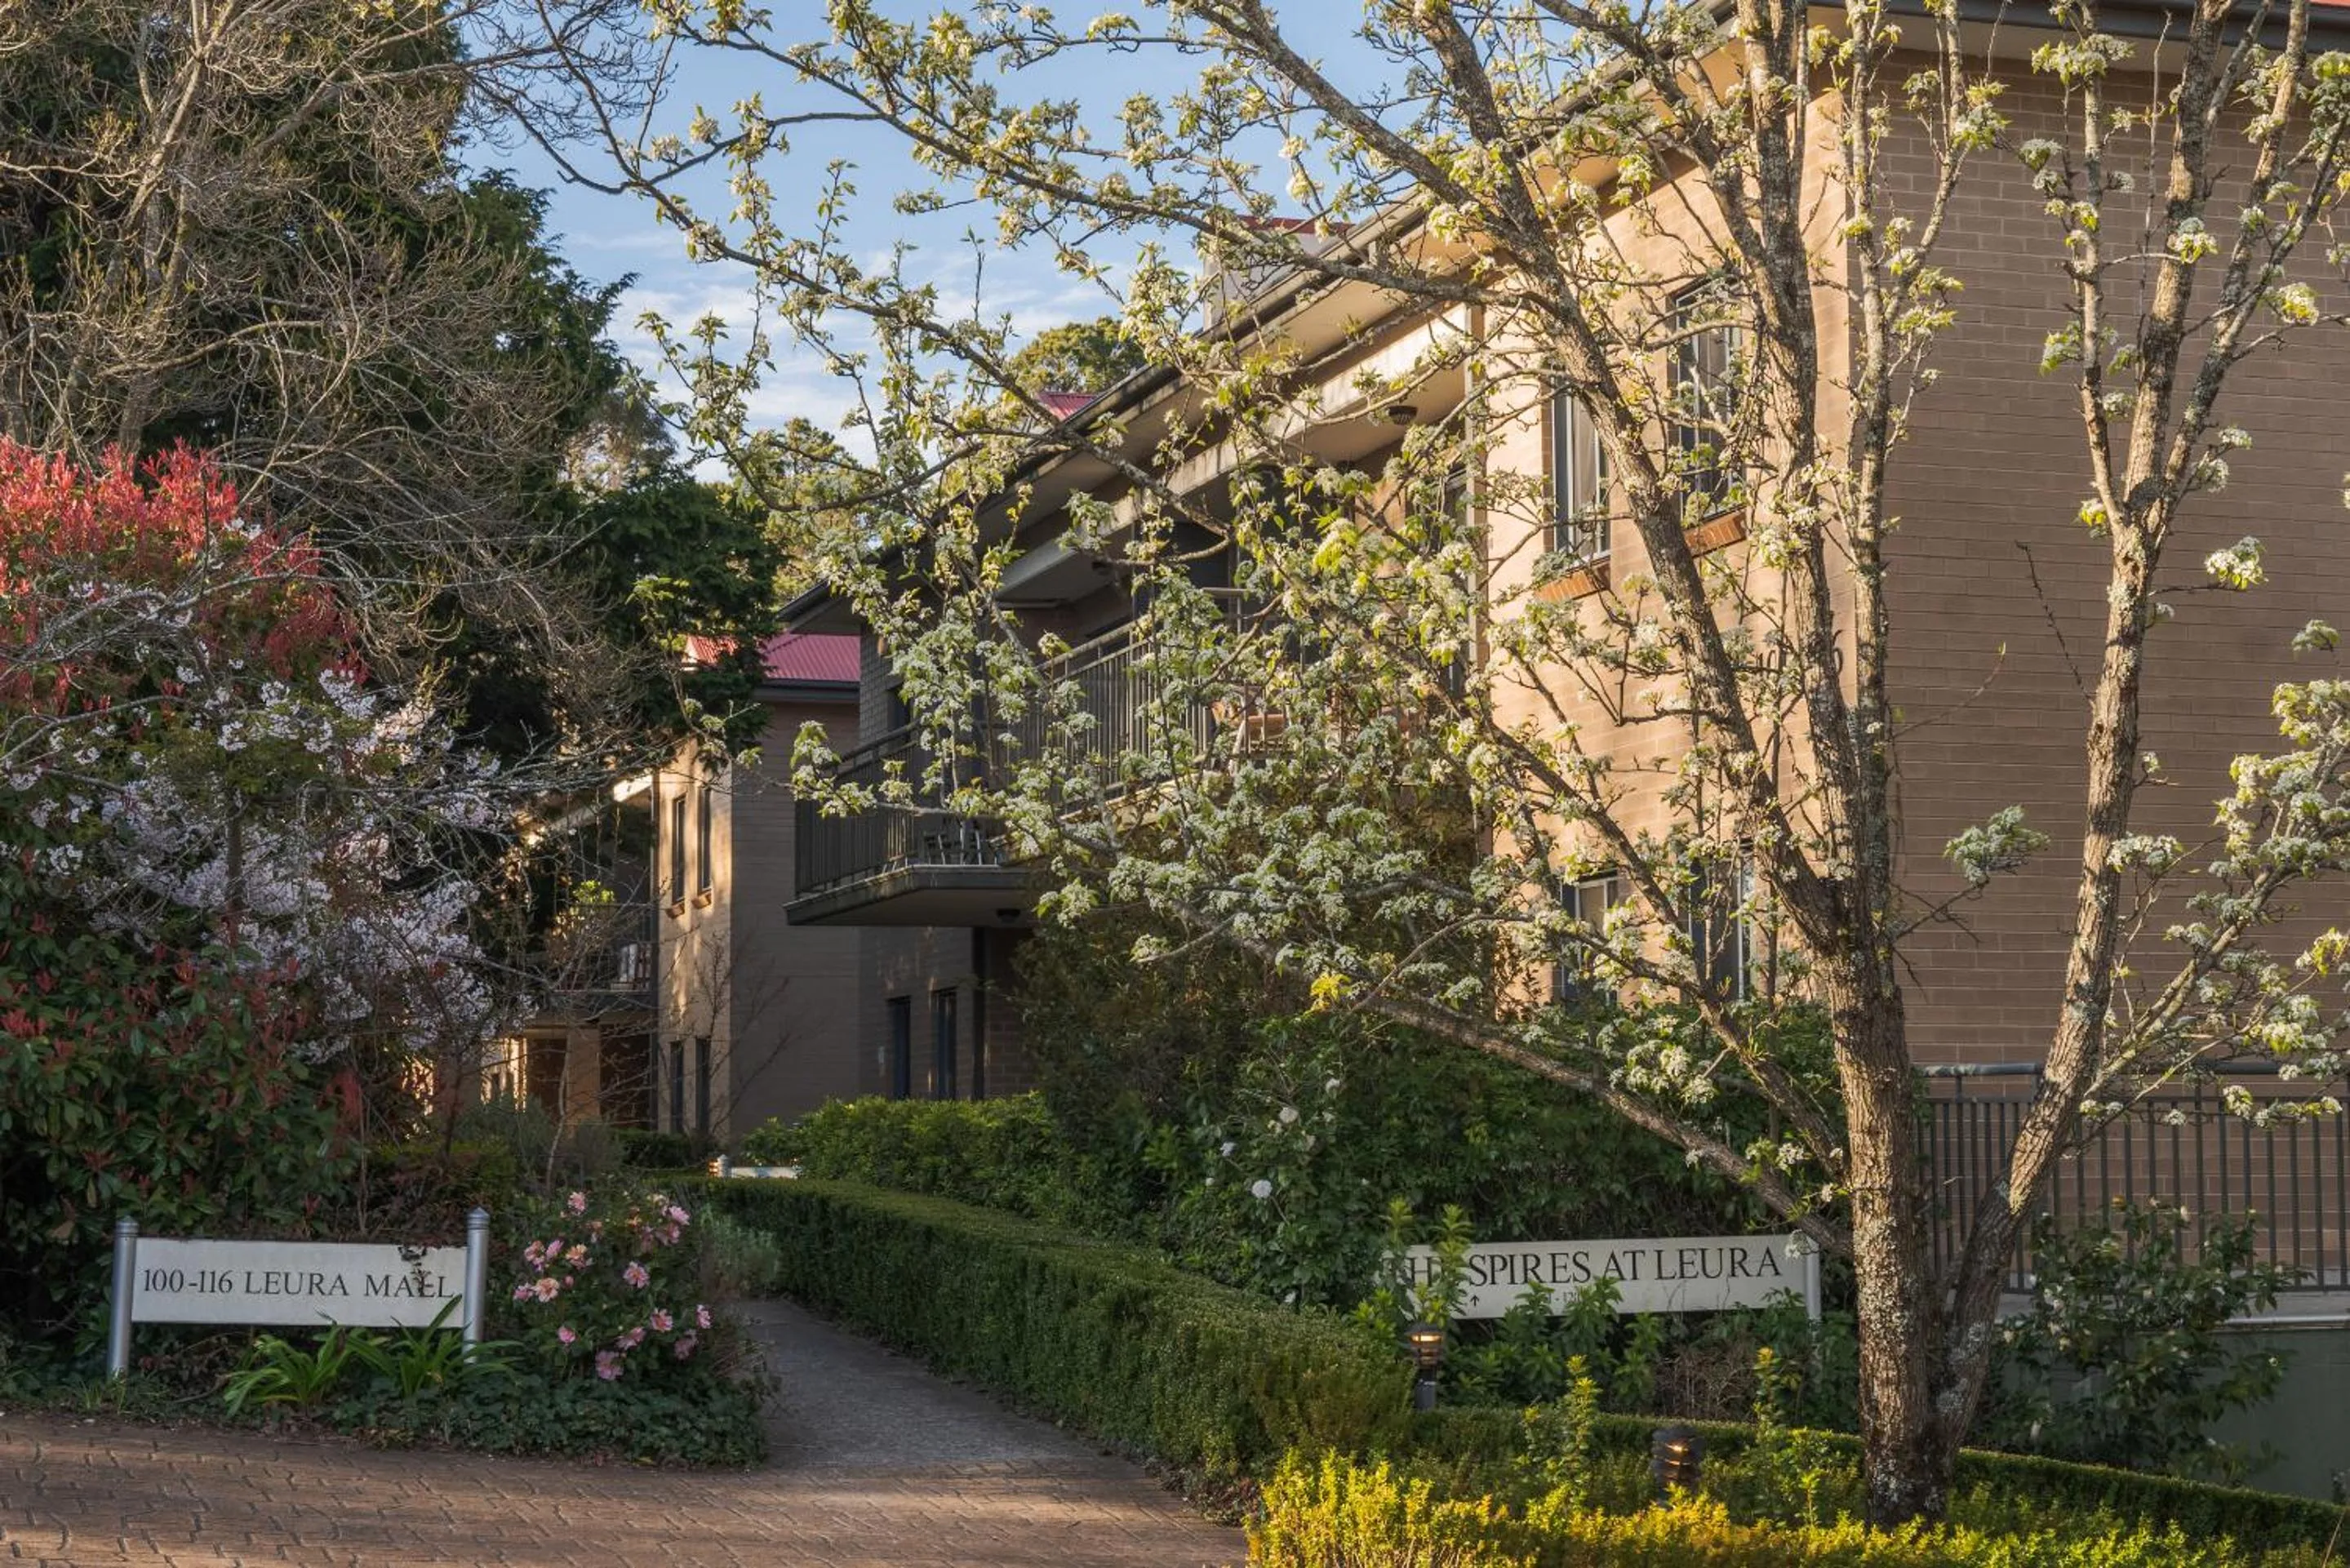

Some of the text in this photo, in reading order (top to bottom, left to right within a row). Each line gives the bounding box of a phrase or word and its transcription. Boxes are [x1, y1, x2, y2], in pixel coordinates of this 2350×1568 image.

[144, 1268, 233, 1294] 100-116
[245, 1271, 349, 1296] LEURA
[1469, 1251, 1590, 1286] SPIRES
[1603, 1250, 1646, 1281] AT
[1655, 1247, 1781, 1280] LEURA
